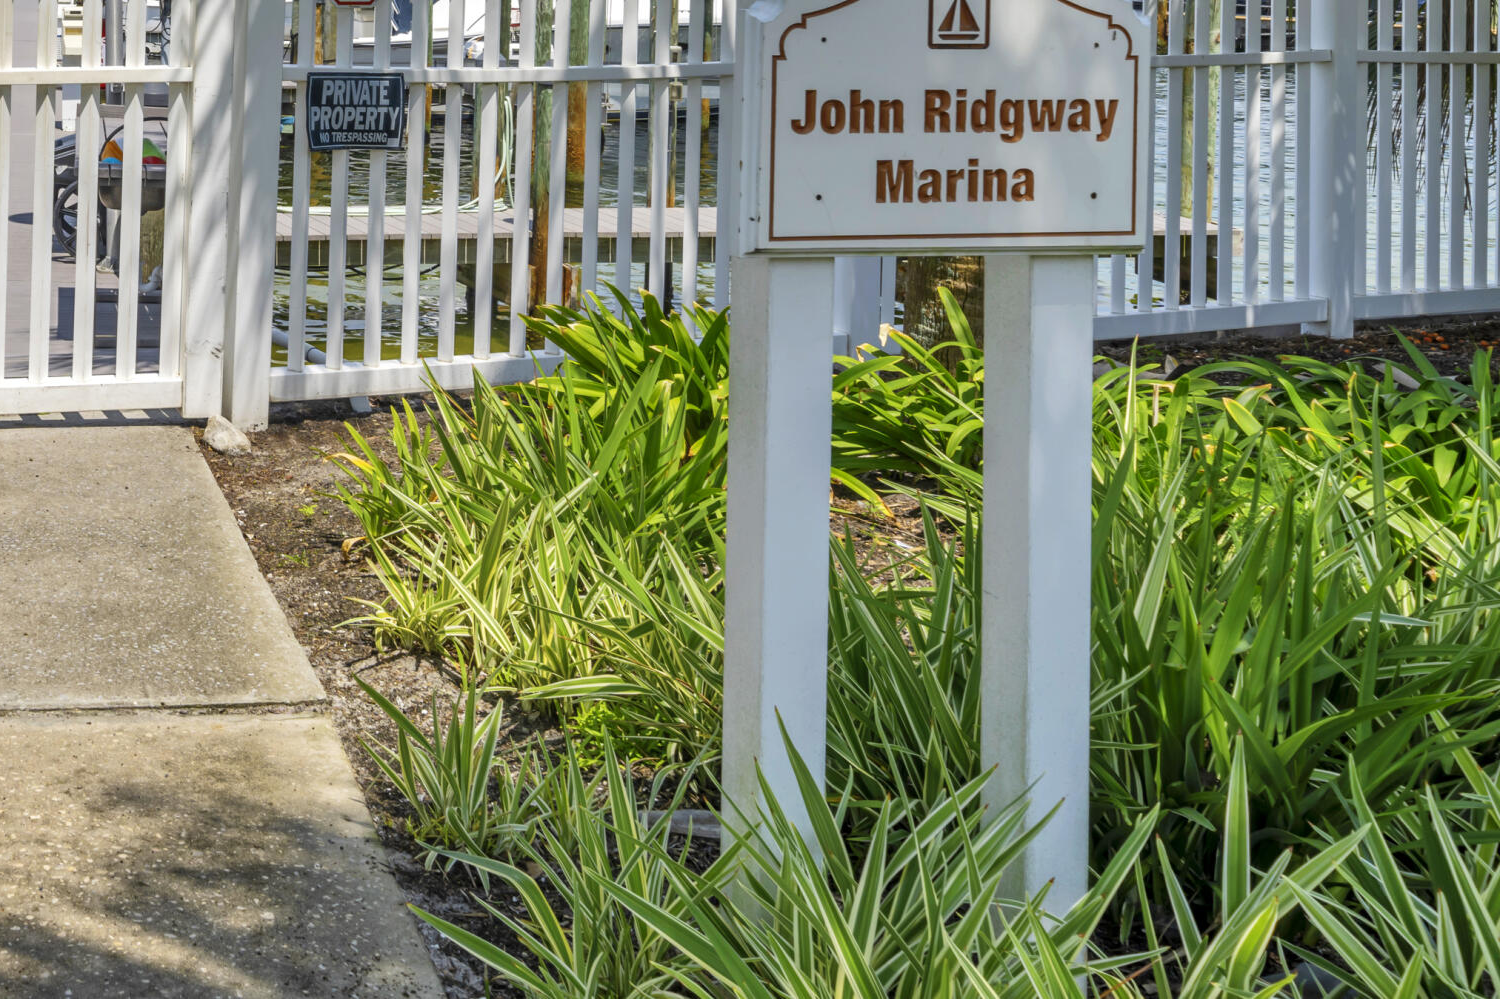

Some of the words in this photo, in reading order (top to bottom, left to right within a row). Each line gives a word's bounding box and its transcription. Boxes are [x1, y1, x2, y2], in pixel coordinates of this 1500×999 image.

[321, 80, 390, 106] PRIVATE
[310, 105, 400, 131] PROPERTY
[790, 89, 904, 135] John
[923, 88, 1119, 143] Ridgway
[319, 132, 330, 143] NO
[331, 131, 388, 144] TRESPASSING
[876, 158, 1035, 204] Marina
